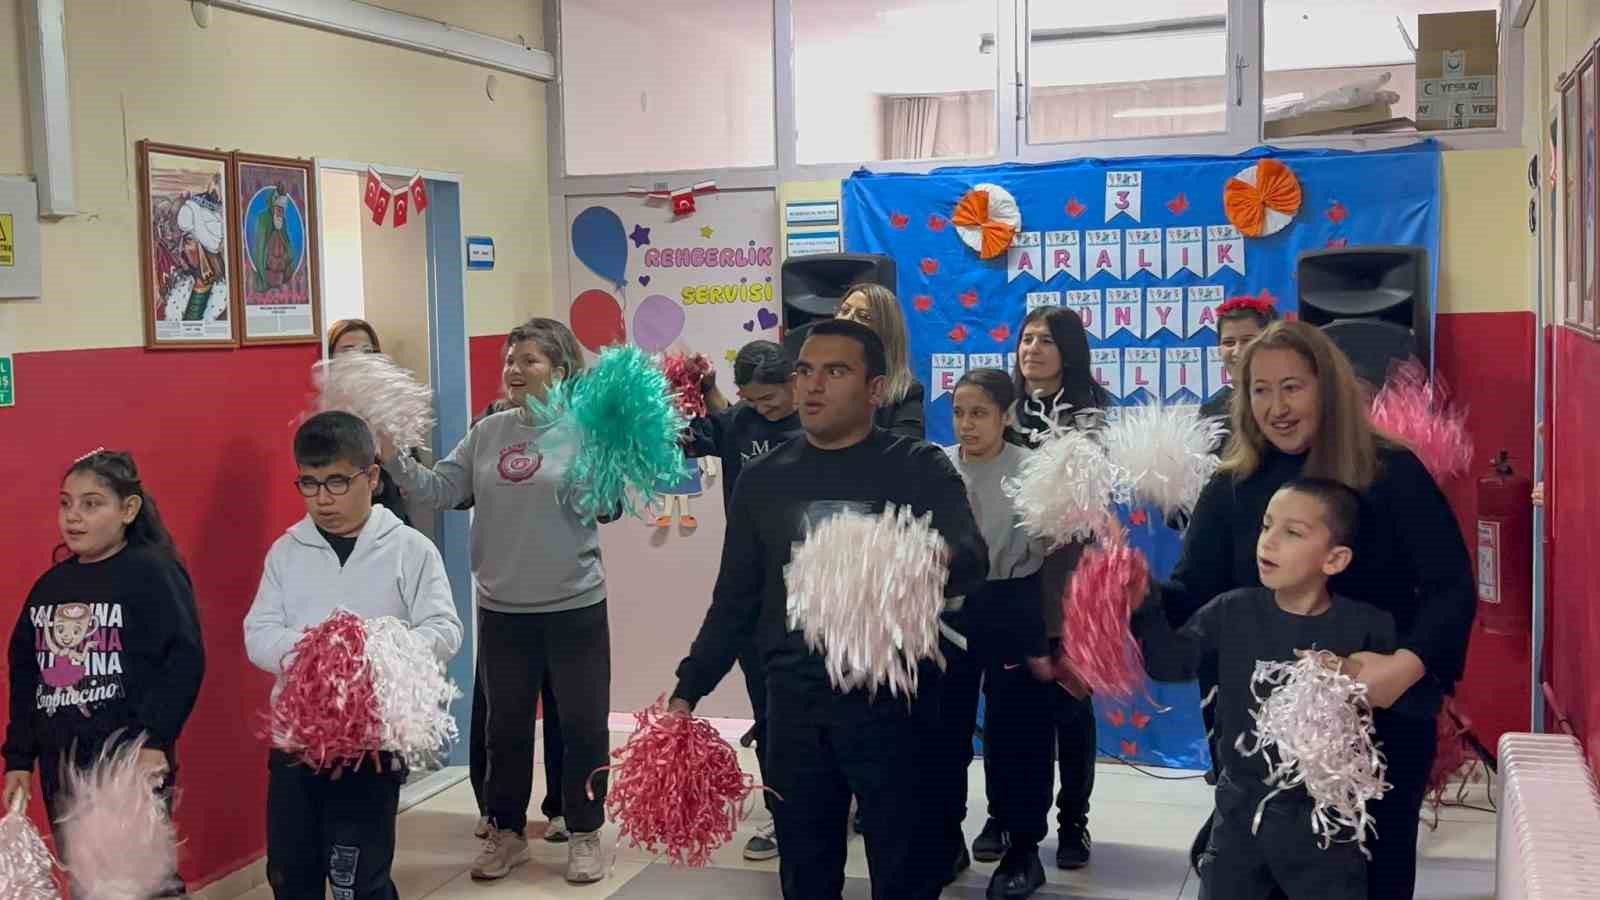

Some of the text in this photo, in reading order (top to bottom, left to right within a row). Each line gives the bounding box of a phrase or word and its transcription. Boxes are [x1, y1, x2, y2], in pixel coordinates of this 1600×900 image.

[1115, 191, 1130, 210] 3
[644, 240, 773, 268] REHBERLİK
[1018, 244, 1235, 270] ARALIK
[681, 276, 774, 305] SERVİSİ
[1077, 305, 1216, 327] ÜNYA
